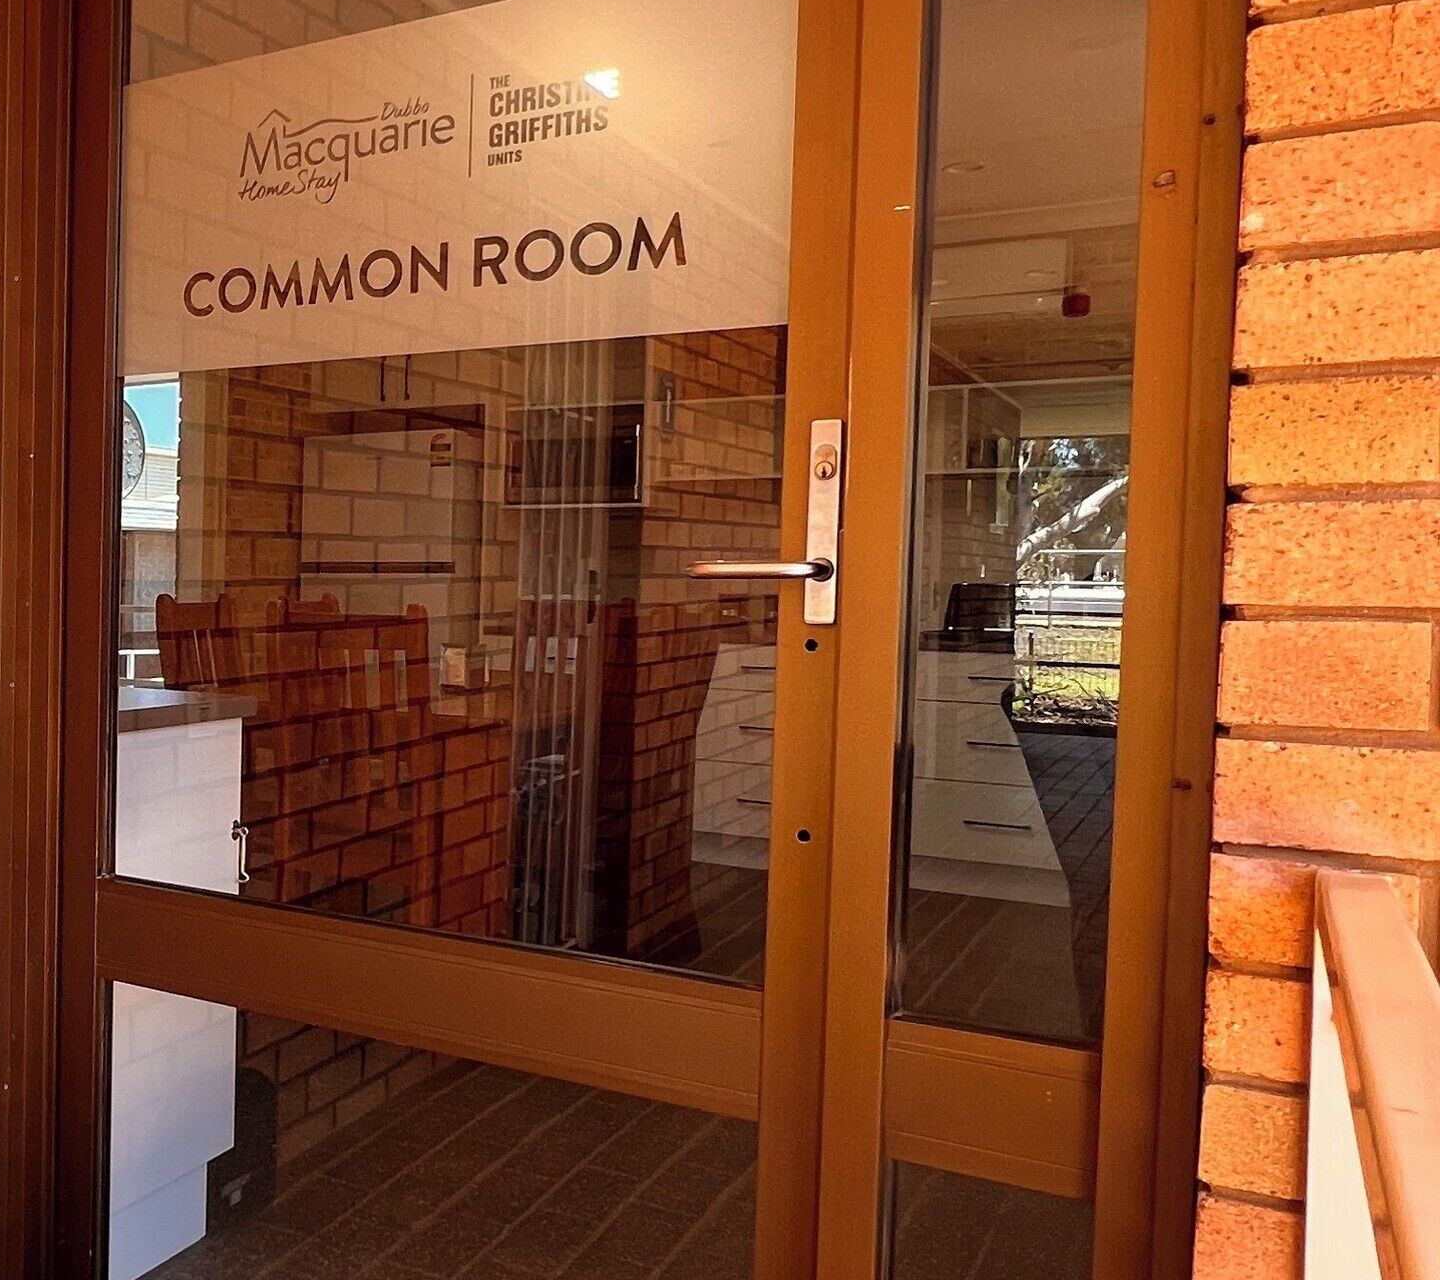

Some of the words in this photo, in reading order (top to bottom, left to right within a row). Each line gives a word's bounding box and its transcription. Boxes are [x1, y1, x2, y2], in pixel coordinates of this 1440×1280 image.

[489, 74, 511, 90] THE
[489, 71, 612, 117] CHRISTI
[381, 96, 430, 120] Dubbo
[488, 105, 609, 148] GRIFFITHS
[240, 114, 456, 183] Macquarie
[487, 149, 523, 167] UNITS
[183, 241, 449, 318] COMMON
[473, 212, 687, 287] ROOM
